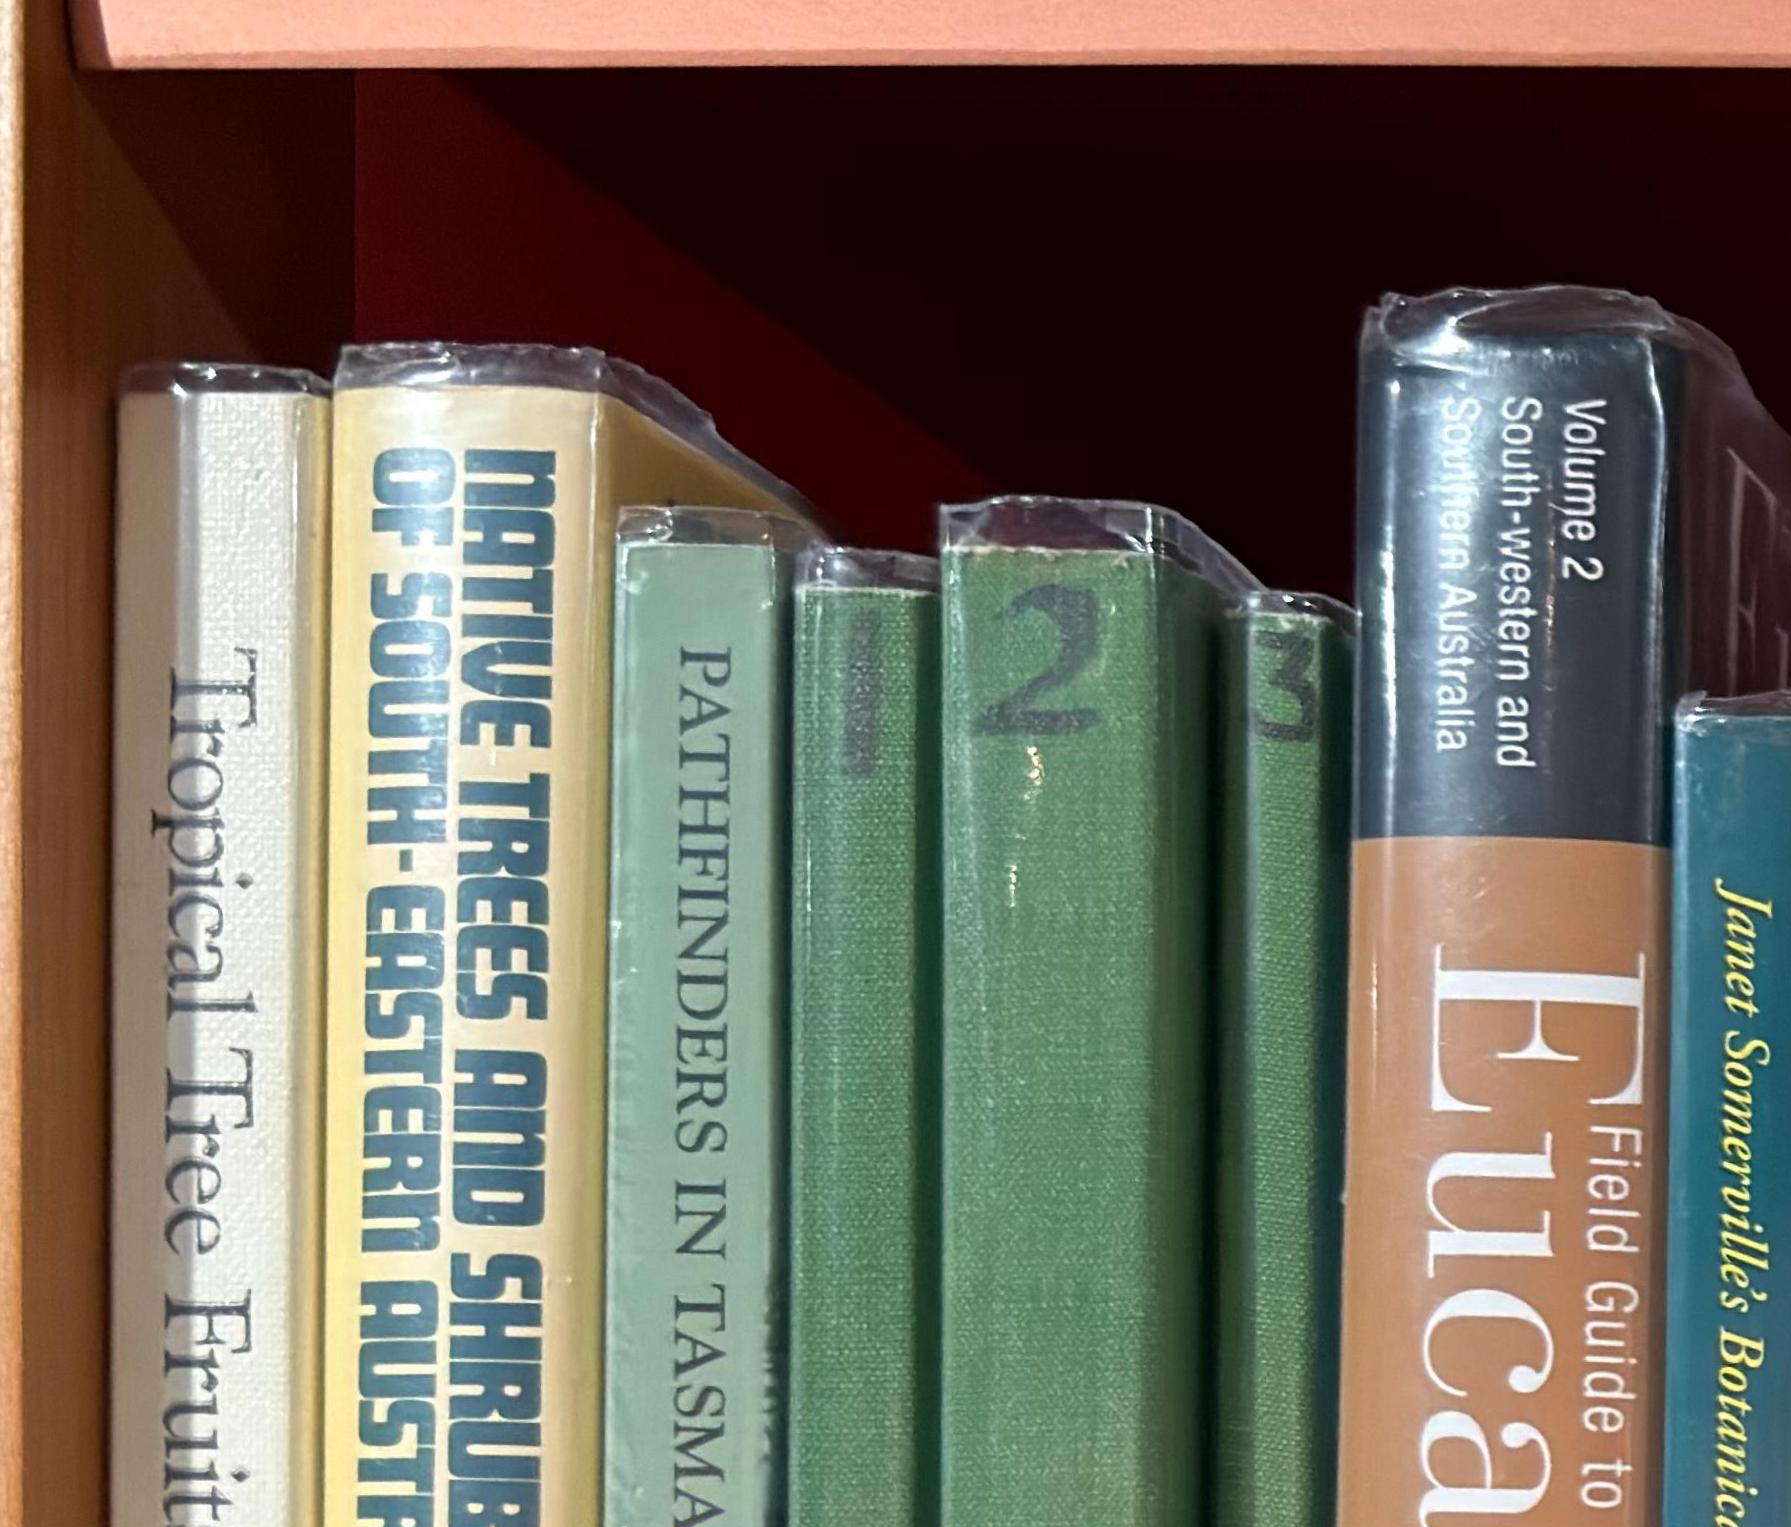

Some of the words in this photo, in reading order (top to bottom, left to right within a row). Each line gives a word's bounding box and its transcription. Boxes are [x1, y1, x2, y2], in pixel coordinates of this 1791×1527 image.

[1498, 396, 1542, 682] South-western
[1561, 397, 1608, 544] Volume
[460, 448, 557, 749] NATIVE
[1562, 556, 1604, 583] 2
[970, 584, 1099, 735] 2
[1256, 630, 1315, 742] 3
[1498, 697, 1536, 769] and
[152, 647, 259, 1020] Tropical
[456, 772, 551, 1022] TREES
[674, 645, 734, 1153] PATHFINDERS
[1716, 877, 1773, 1018] Janet
[163, 1046, 252, 1256] Tree
[452, 1050, 548, 1227] AND
[1587, 1123, 1644, 1253] Field
[1717, 1029, 1773, 1315] Somerville's
[673, 1180, 728, 1259] IN
[1581, 1281, 1639, 1433] Guide
[1580, 1458, 1634, 1509] to
